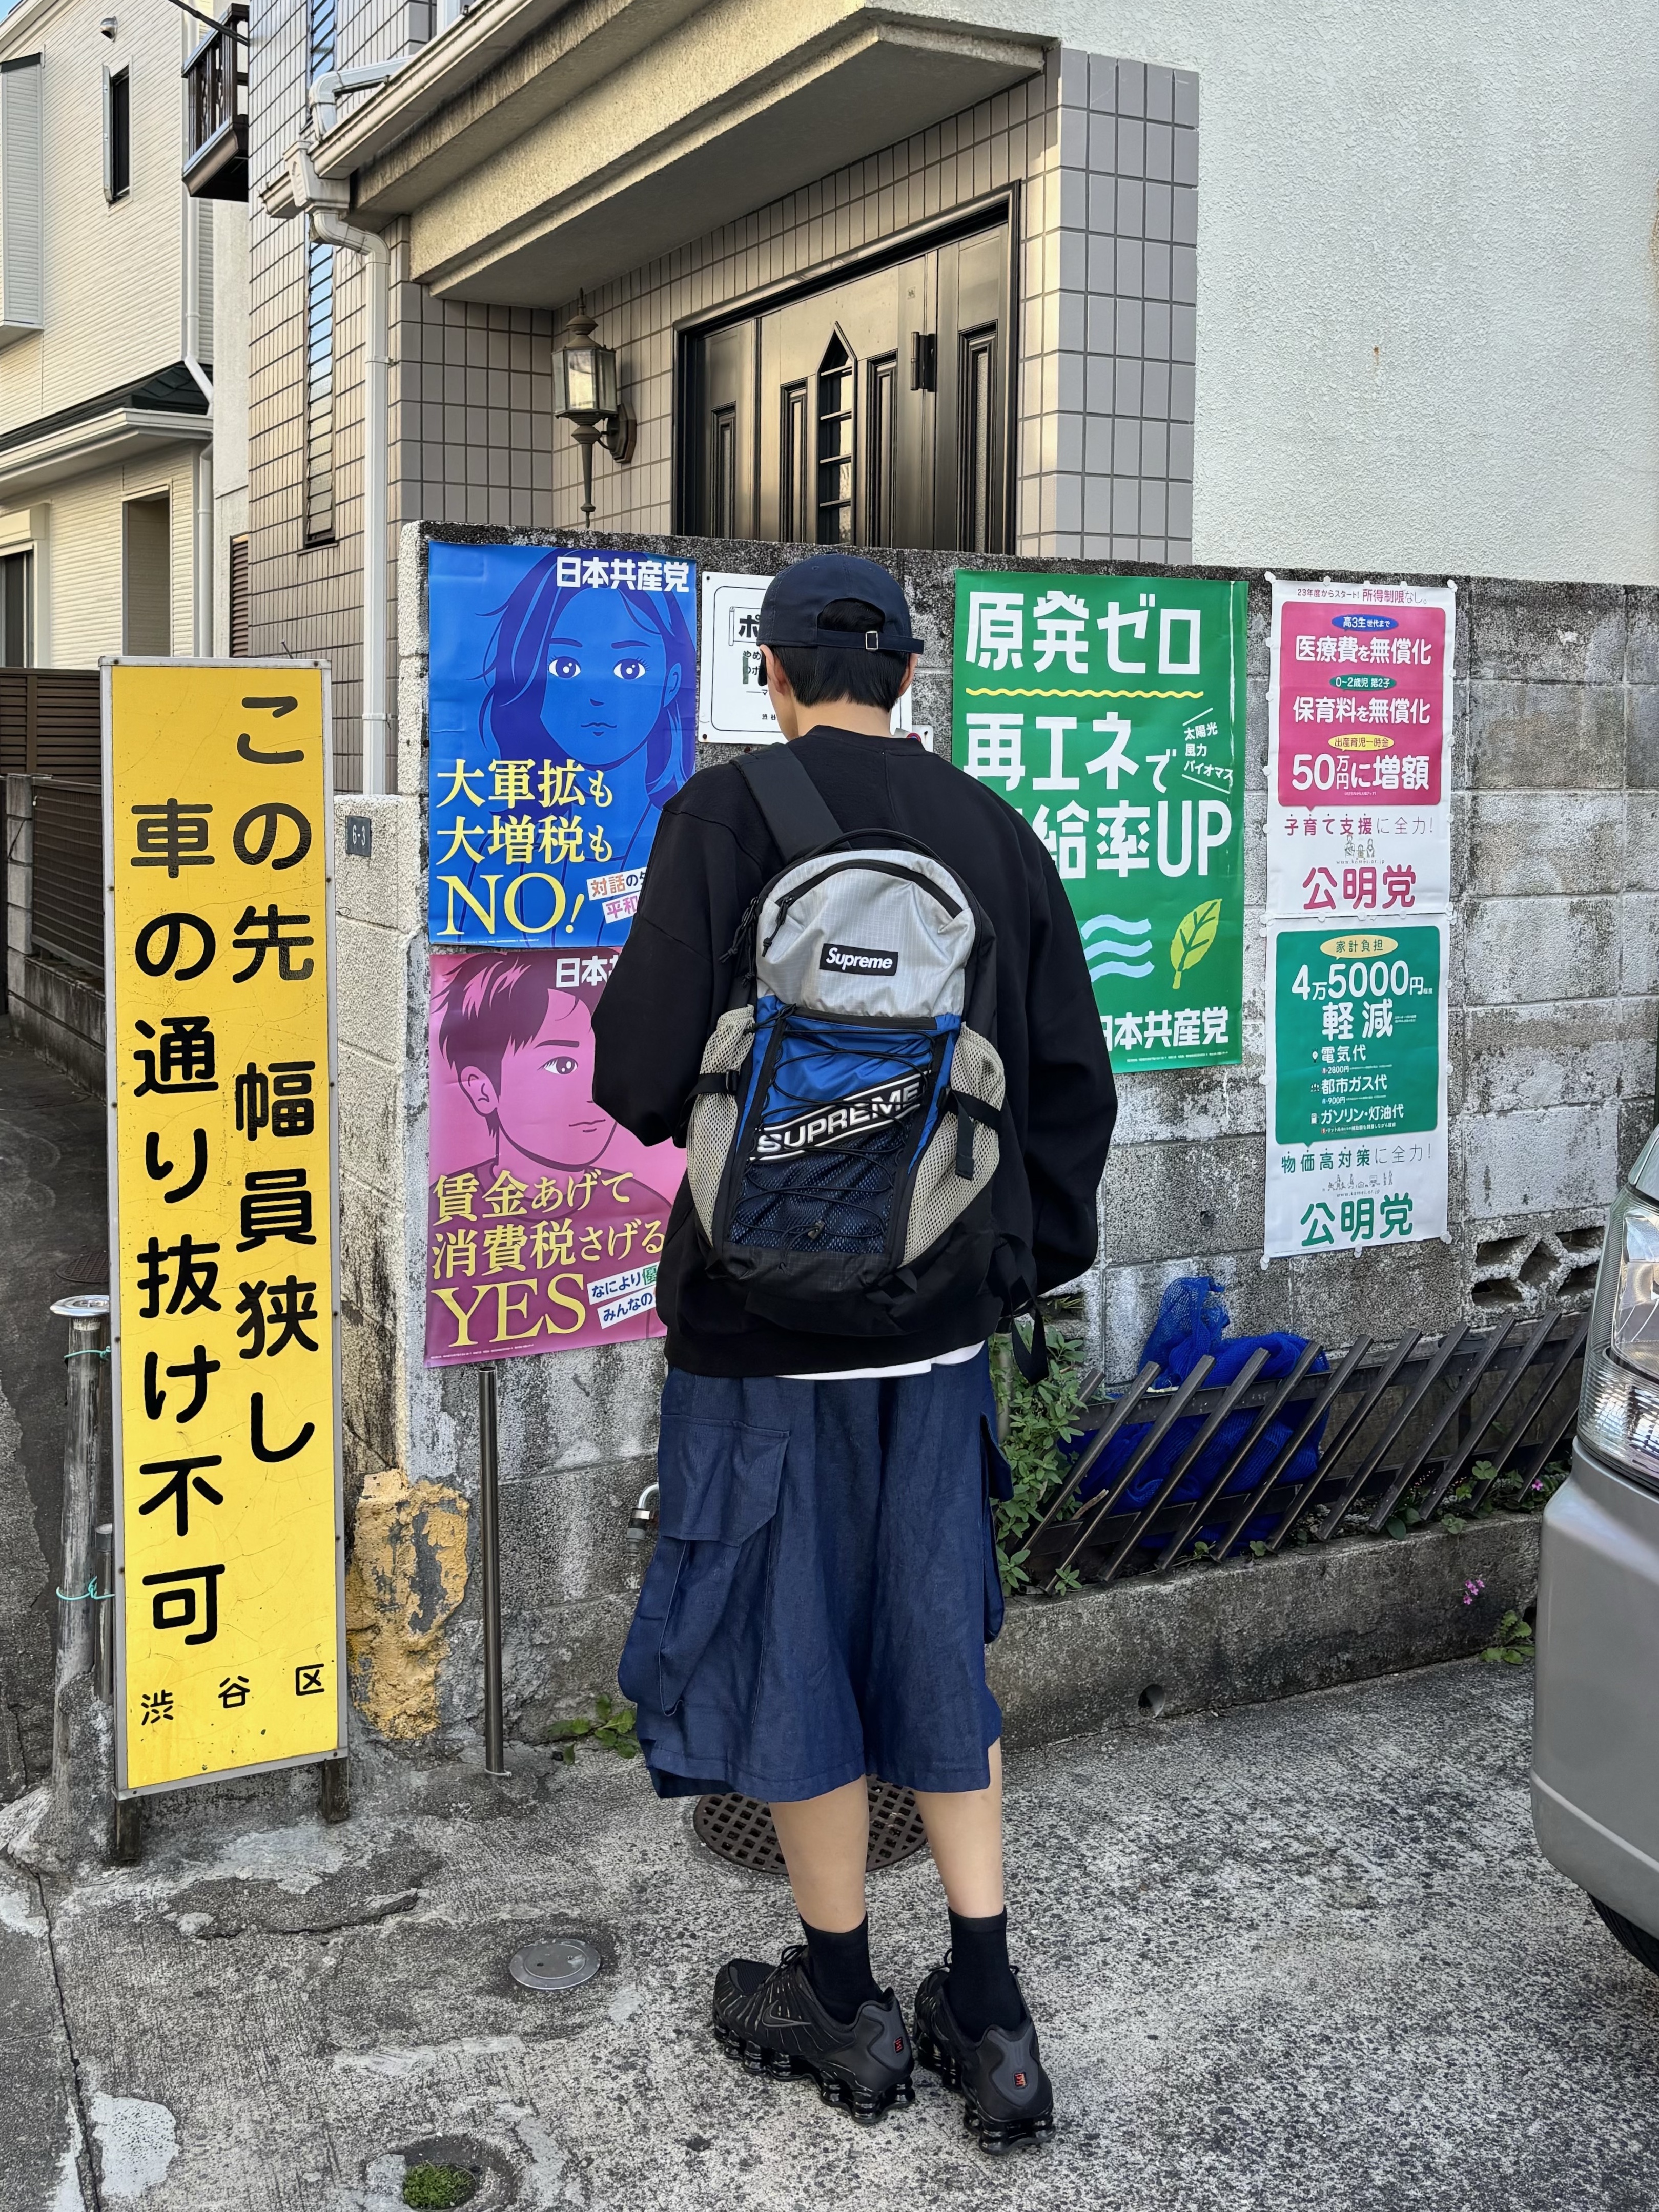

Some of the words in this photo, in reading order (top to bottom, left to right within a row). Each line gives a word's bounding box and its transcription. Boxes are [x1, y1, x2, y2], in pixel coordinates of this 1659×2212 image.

[557, 556, 689, 592] 日本共産党
[965, 590, 1201, 675] 原発ゼロ
[1295, 635, 1432, 665] 医療費を無償化
[1293, 695, 1430, 725] 保育料を無償化
[1184, 722, 1218, 741] 太陽光
[1185, 743, 1207, 757] 風力
[1334, 737, 1389, 748] 出産育児一時金
[964, 711, 1177, 793] 再エネで
[436, 758, 613, 809] 大軍拡も
[1183, 760, 1234, 782] バイオマス
[1292, 753, 1430, 791] 50万円に増額
[436, 814, 613, 865] 大増税も
[1014, 799, 1233, 879] 給率UP
[1284, 816, 1433, 836] 子育て支援に全力!
[436, 872, 586, 936] NO!
[1302, 864, 1416, 910] 公明党
[826, 947, 893, 970] Supreme
[1336, 939, 1384, 953] 家計負担
[1321, 998, 1394, 1041] 軽減
[1321, 1044, 1367, 1063] 電気代
[1321, 1074, 1388, 1095] 都市ガス代
[757, 1082, 920, 1154] SUPREME
[1321, 1103, 1404, 1125] ガソリン・灯油代
[1281, 1143, 1431, 1174] 物価高対策に全力!
[433, 1168, 634, 1226] 賃金あげて
[130, 797, 226, 1646] 車の通り抜け不可
[1300, 1192, 1414, 1247] 公明党
[432, 1217, 666, 1280] 消費税さげる
[431, 1272, 587, 1348] YES
[603, 1287, 656, 1322] みんなの
